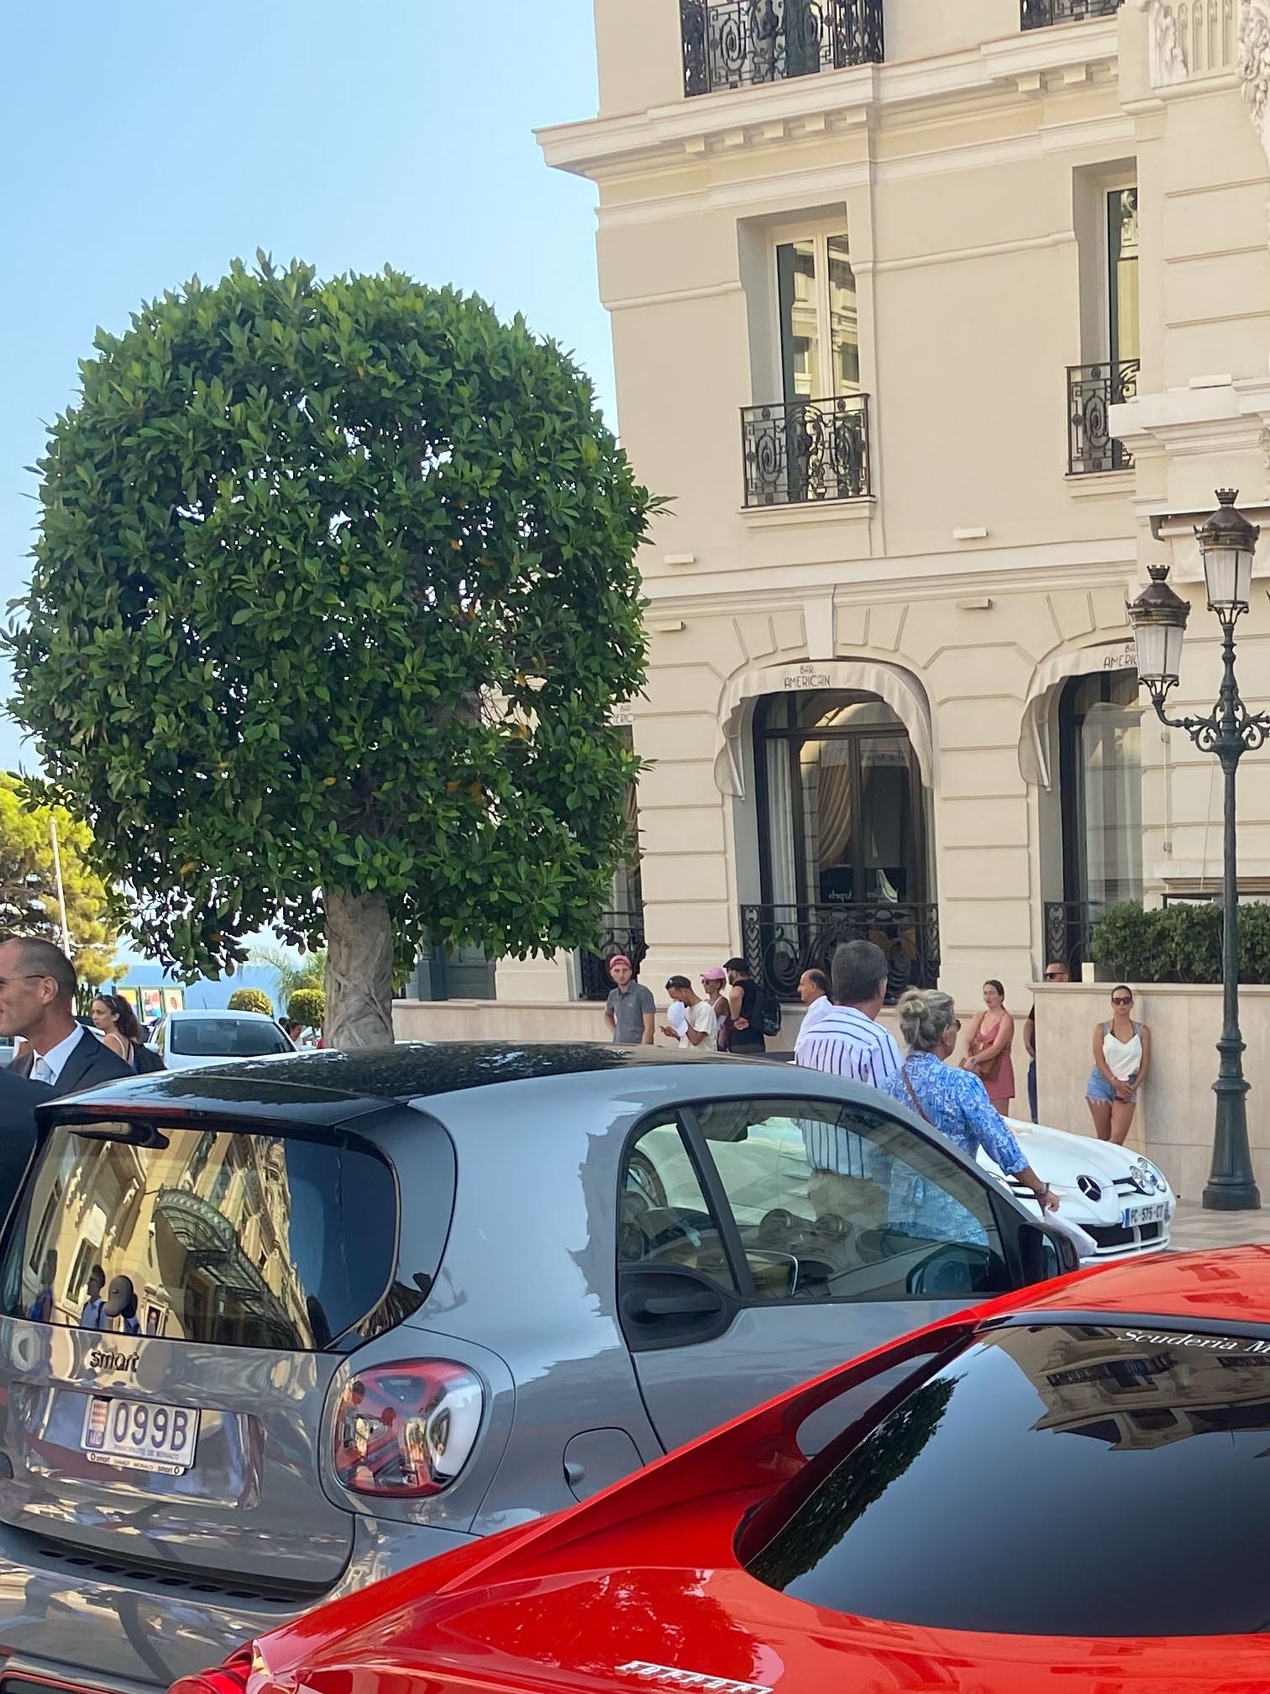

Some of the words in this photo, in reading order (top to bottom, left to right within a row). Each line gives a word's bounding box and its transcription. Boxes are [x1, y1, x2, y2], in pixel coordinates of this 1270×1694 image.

[1124, 644, 1137, 654] BA
[800, 665, 814, 675] BAR
[784, 675, 831, 689] AMERICAIN
[1116, 1329, 1238, 1351] Scuderia
[89, 1351, 140, 1373] smart
[113, 1402, 188, 1451] 099B
